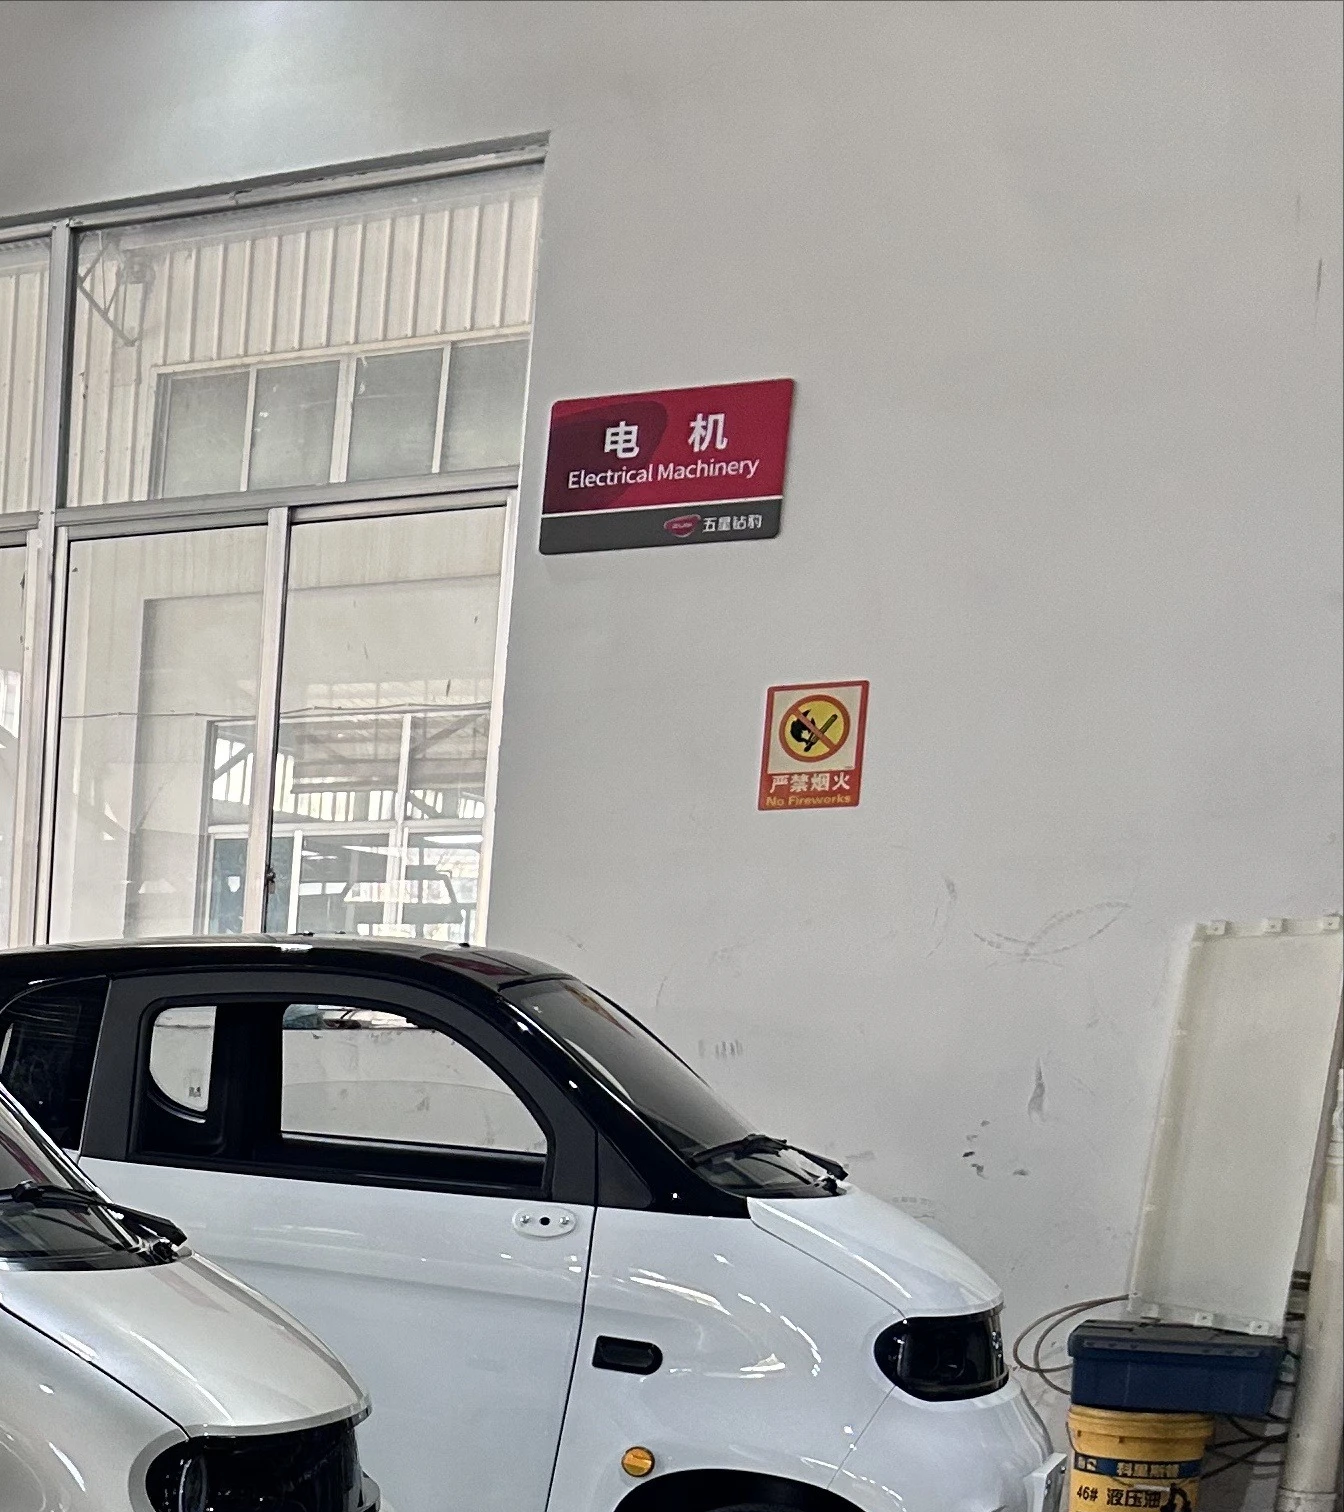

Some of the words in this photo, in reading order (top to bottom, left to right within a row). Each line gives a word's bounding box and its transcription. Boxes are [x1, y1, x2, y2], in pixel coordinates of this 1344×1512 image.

[604, 413, 728, 459] 电机
[568, 464, 653, 489] Electrical
[658, 459, 760, 481] Machinery
[769, 772, 850, 793] 严禁烟火
[766, 796, 785, 807] No
[788, 794, 851, 806] Fireworks
[1076, 1485, 1098, 1502] 46#
[1106, 1487, 1162, 1509] 液压油
